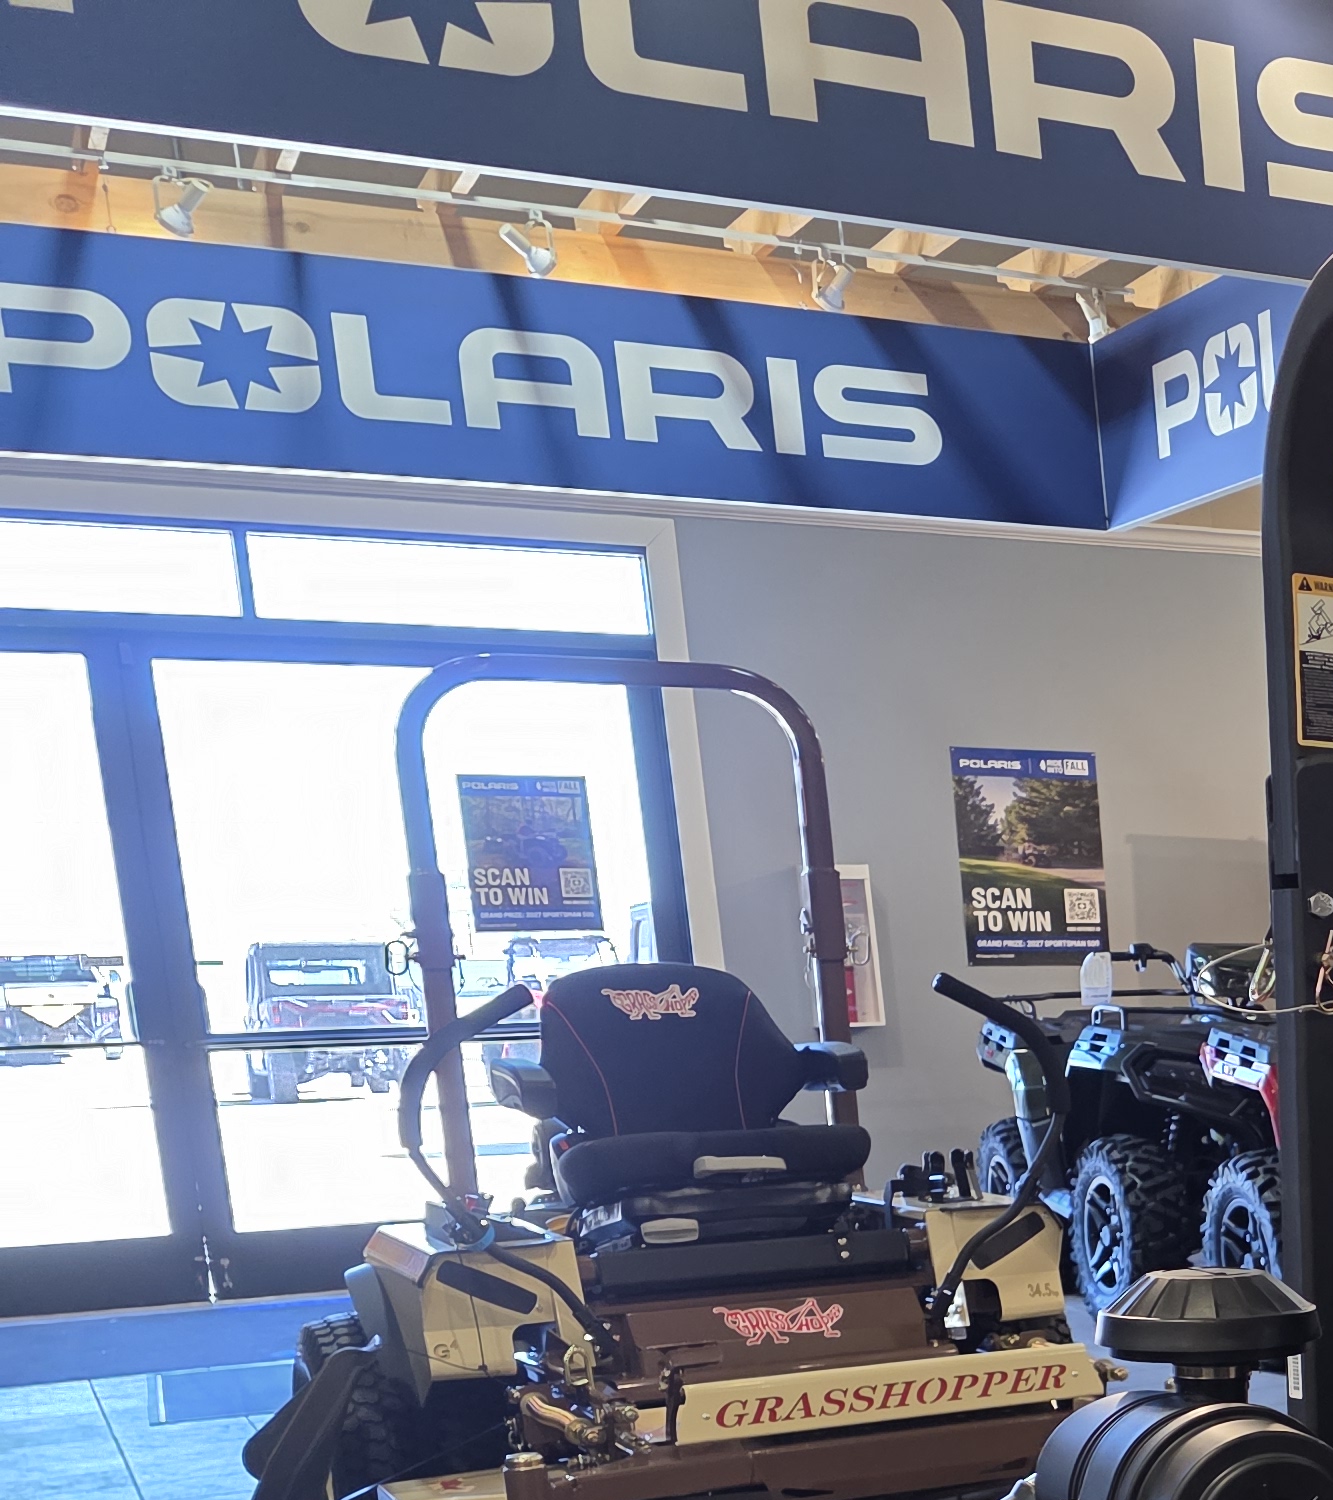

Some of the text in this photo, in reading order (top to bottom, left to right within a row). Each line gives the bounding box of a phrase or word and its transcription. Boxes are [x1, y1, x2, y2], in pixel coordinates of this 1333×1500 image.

[0, 282, 943, 466] POLARIS
[959, 759, 1021, 770] POLARIS
[1065, 761, 1086, 772] FALL
[461, 781, 519, 790] POLARIS
[473, 868, 530, 886] SCAN
[475, 887, 549, 906] TO WIN
[971, 887, 1032, 909] SCAN
[973, 910, 1052, 932] TO WIN
[715, 1363, 1067, 1430] GRASSHOPPER
